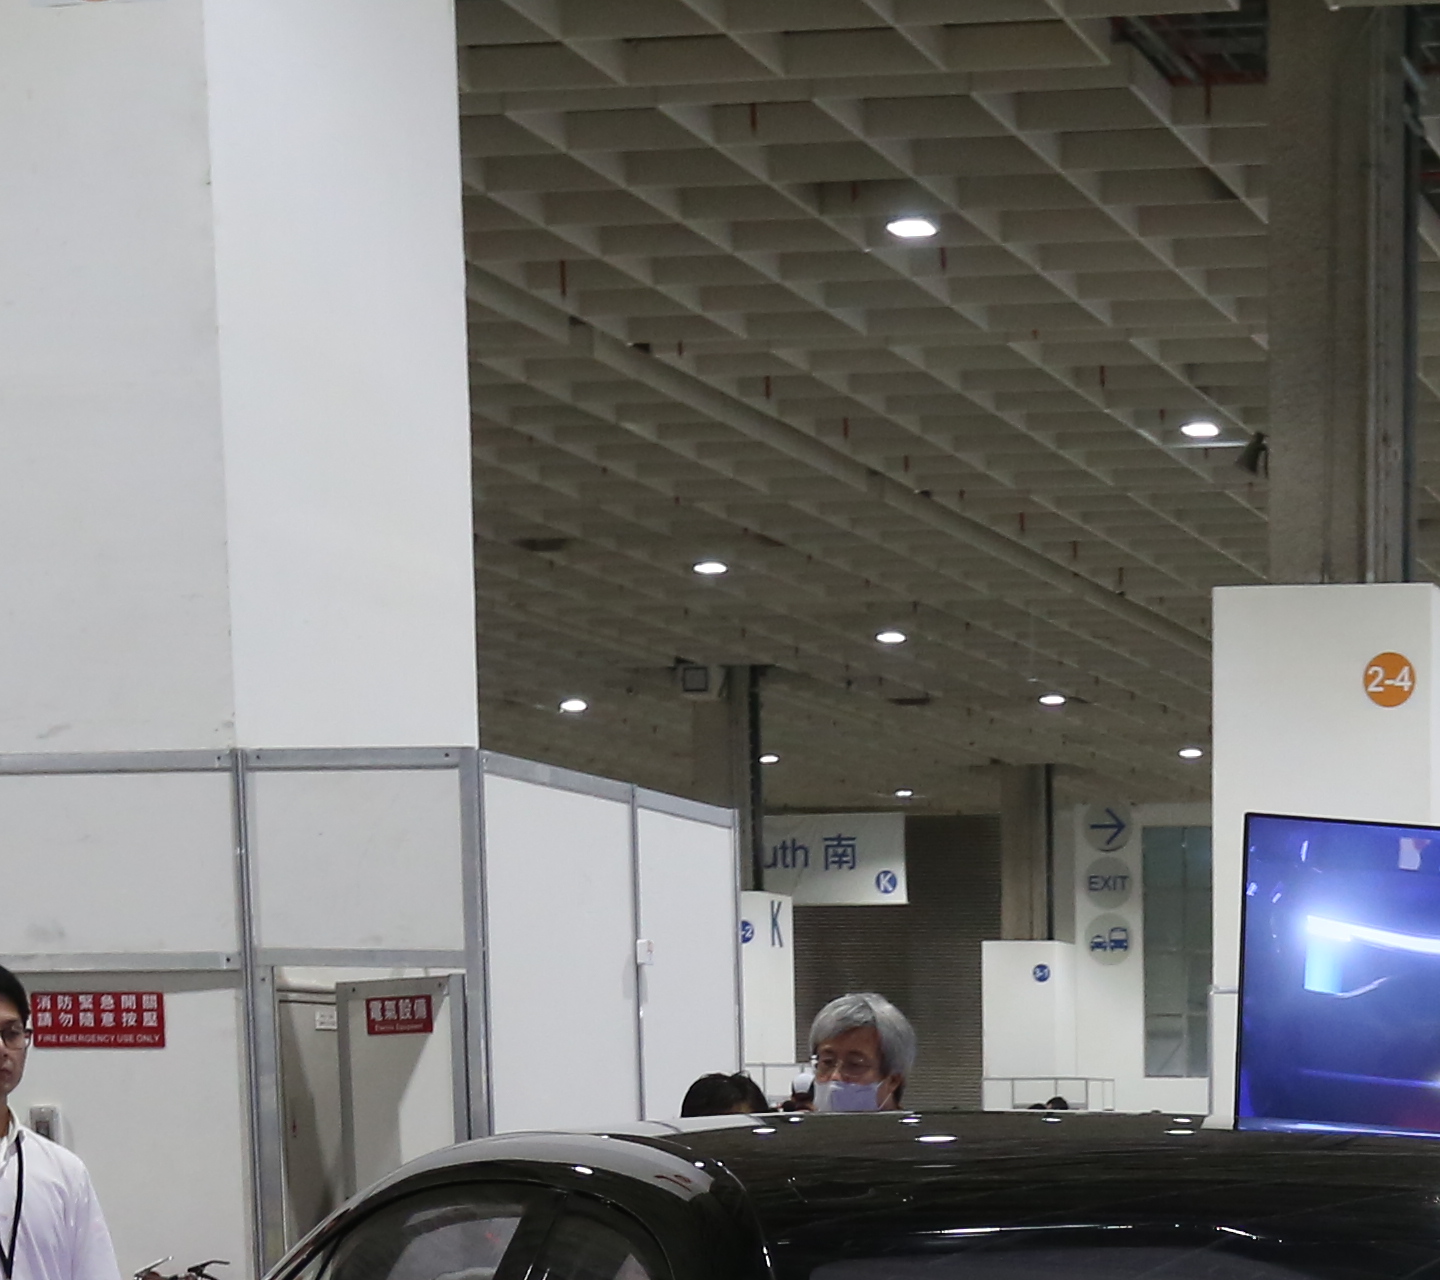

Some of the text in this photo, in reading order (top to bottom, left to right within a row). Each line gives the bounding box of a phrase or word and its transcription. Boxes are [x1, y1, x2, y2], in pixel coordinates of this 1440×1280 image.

[1367, 665, 1413, 694] 2-4
[763, 833, 857, 871] uth 南
[878, 871, 895, 892] K
[1088, 875, 1130, 891] EXIT
[770, 900, 783, 948] K
[37, 994, 158, 1011] 消防緊急開關
[368, 999, 427, 1021] 電氣設備
[37, 1011, 158, 1028] 請勿隨意按壓
[38, 1033, 160, 1043] FIRE EMERGENCY USE ONLY
